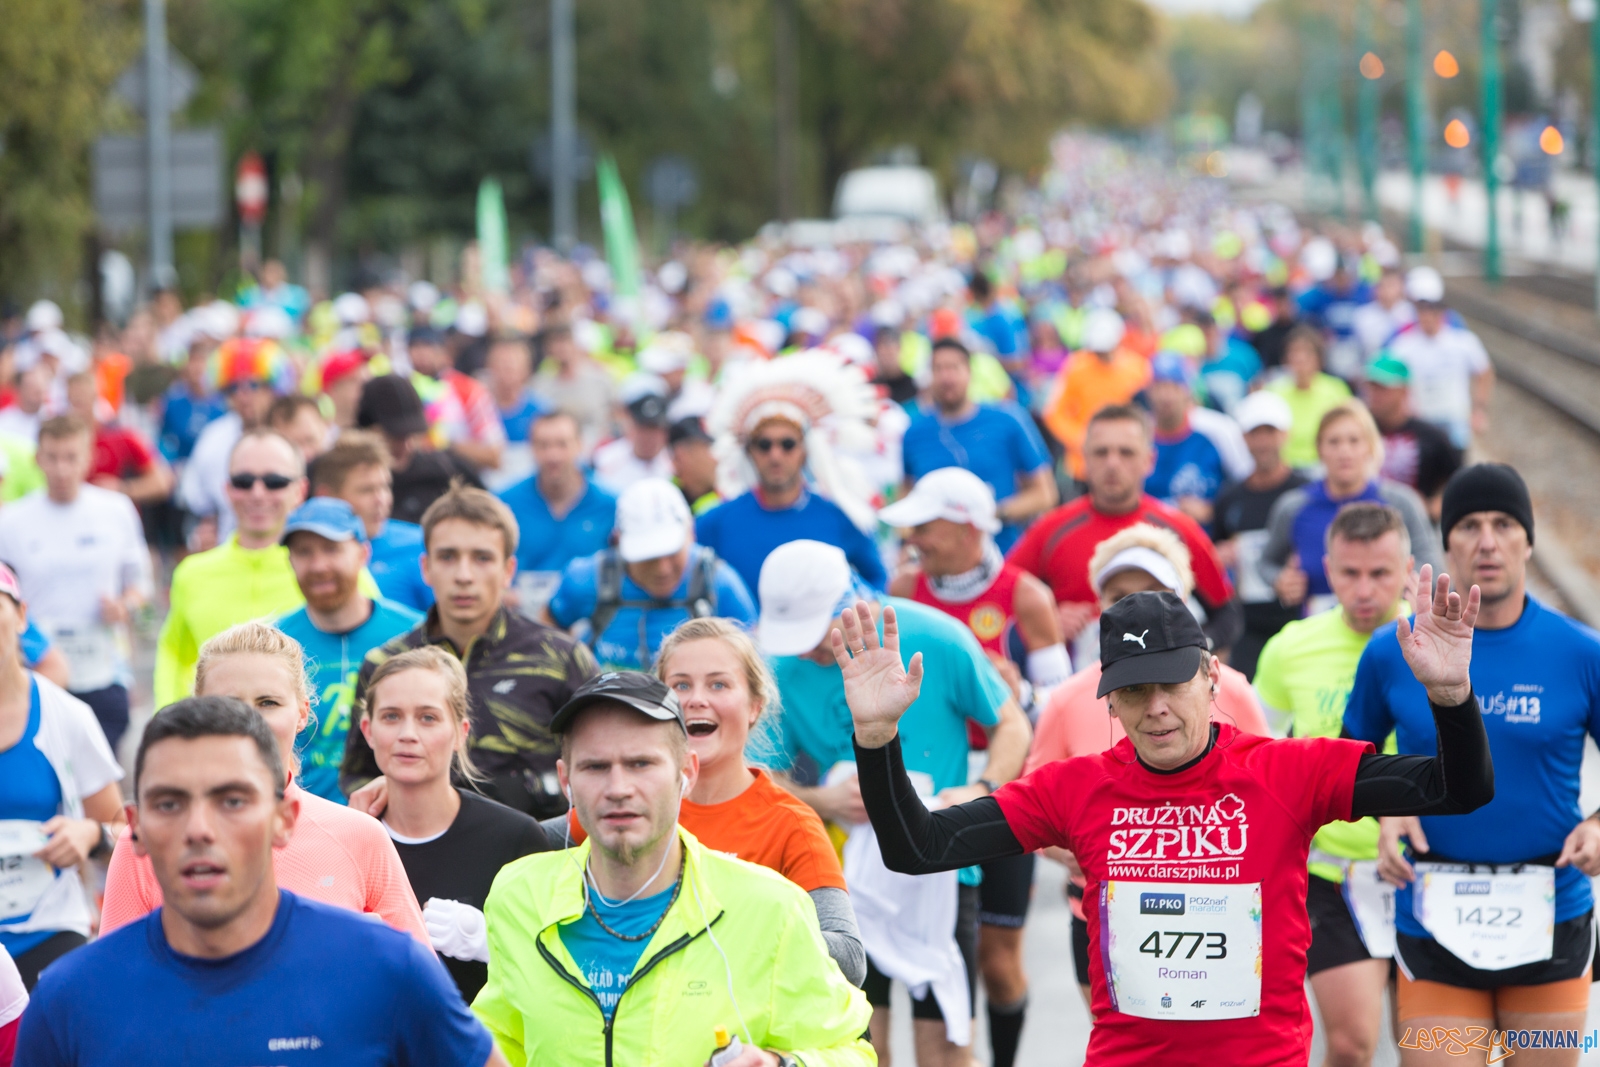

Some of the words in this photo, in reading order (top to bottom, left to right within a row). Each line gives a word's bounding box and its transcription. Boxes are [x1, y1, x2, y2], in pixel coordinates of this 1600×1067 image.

[1111, 801, 1223, 826] DRUŻYNA
[1107, 824, 1249, 860] SZPIKU
[1108, 864, 1239, 880] www.darszpiku.pl
[1455, 907, 1523, 928] 1422
[1139, 931, 1227, 960] 4773
[1158, 967, 1208, 980] Roman
[1190, 999, 1207, 1008] 4F
